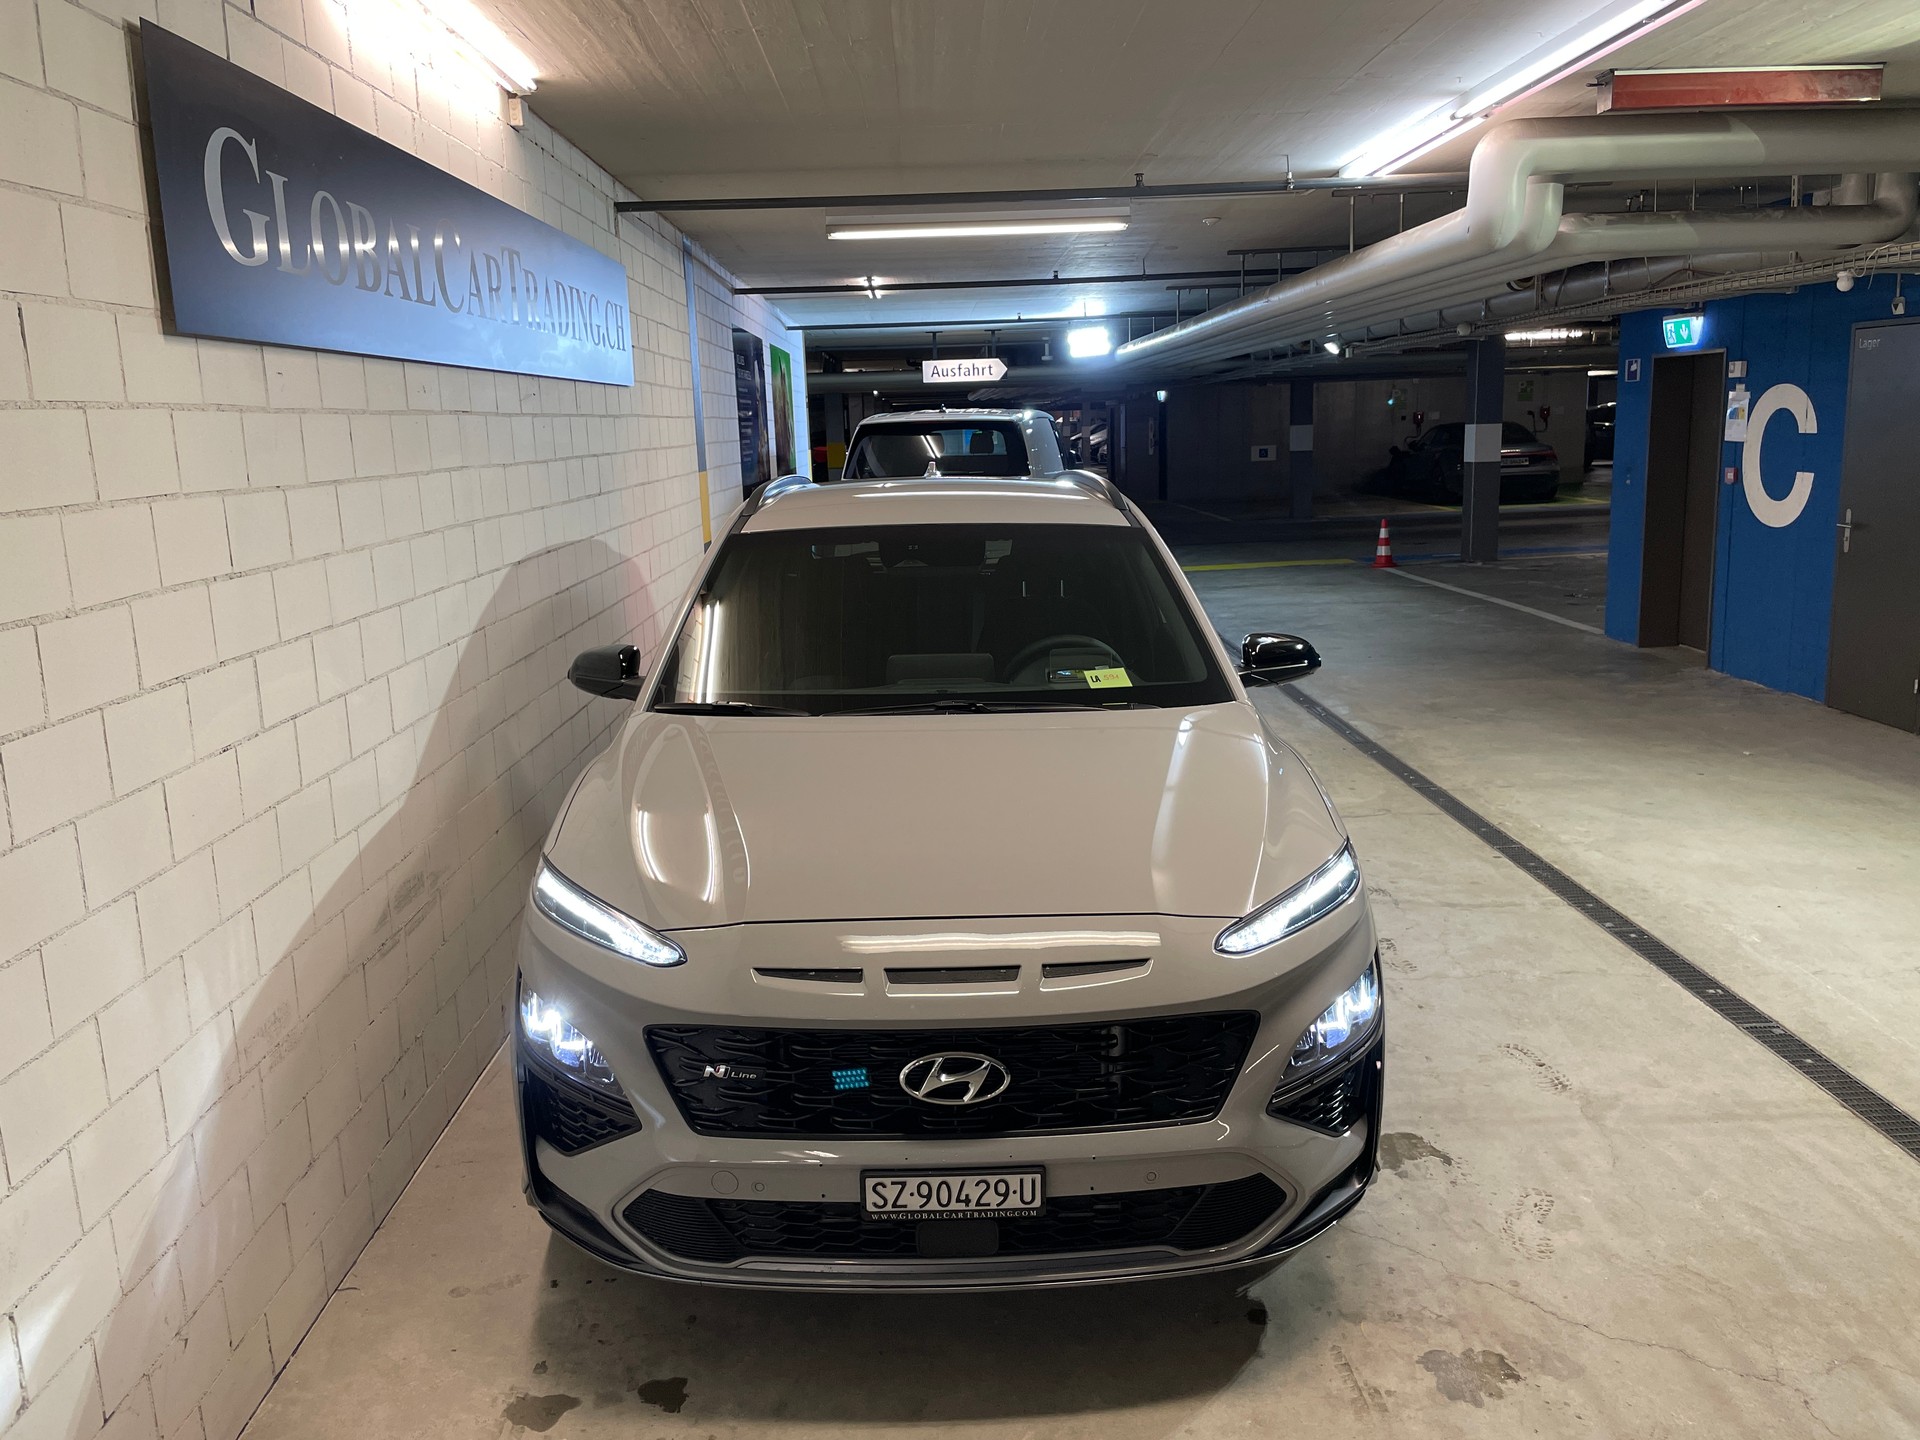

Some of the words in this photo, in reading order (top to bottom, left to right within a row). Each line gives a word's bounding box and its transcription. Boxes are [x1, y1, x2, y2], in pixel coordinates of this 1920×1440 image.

[1859, 338, 1881, 351] Lager
[930, 363, 993, 378] Ausfahrt
[1742, 383, 1818, 528] C
[730, 1071, 757, 1080] Line
